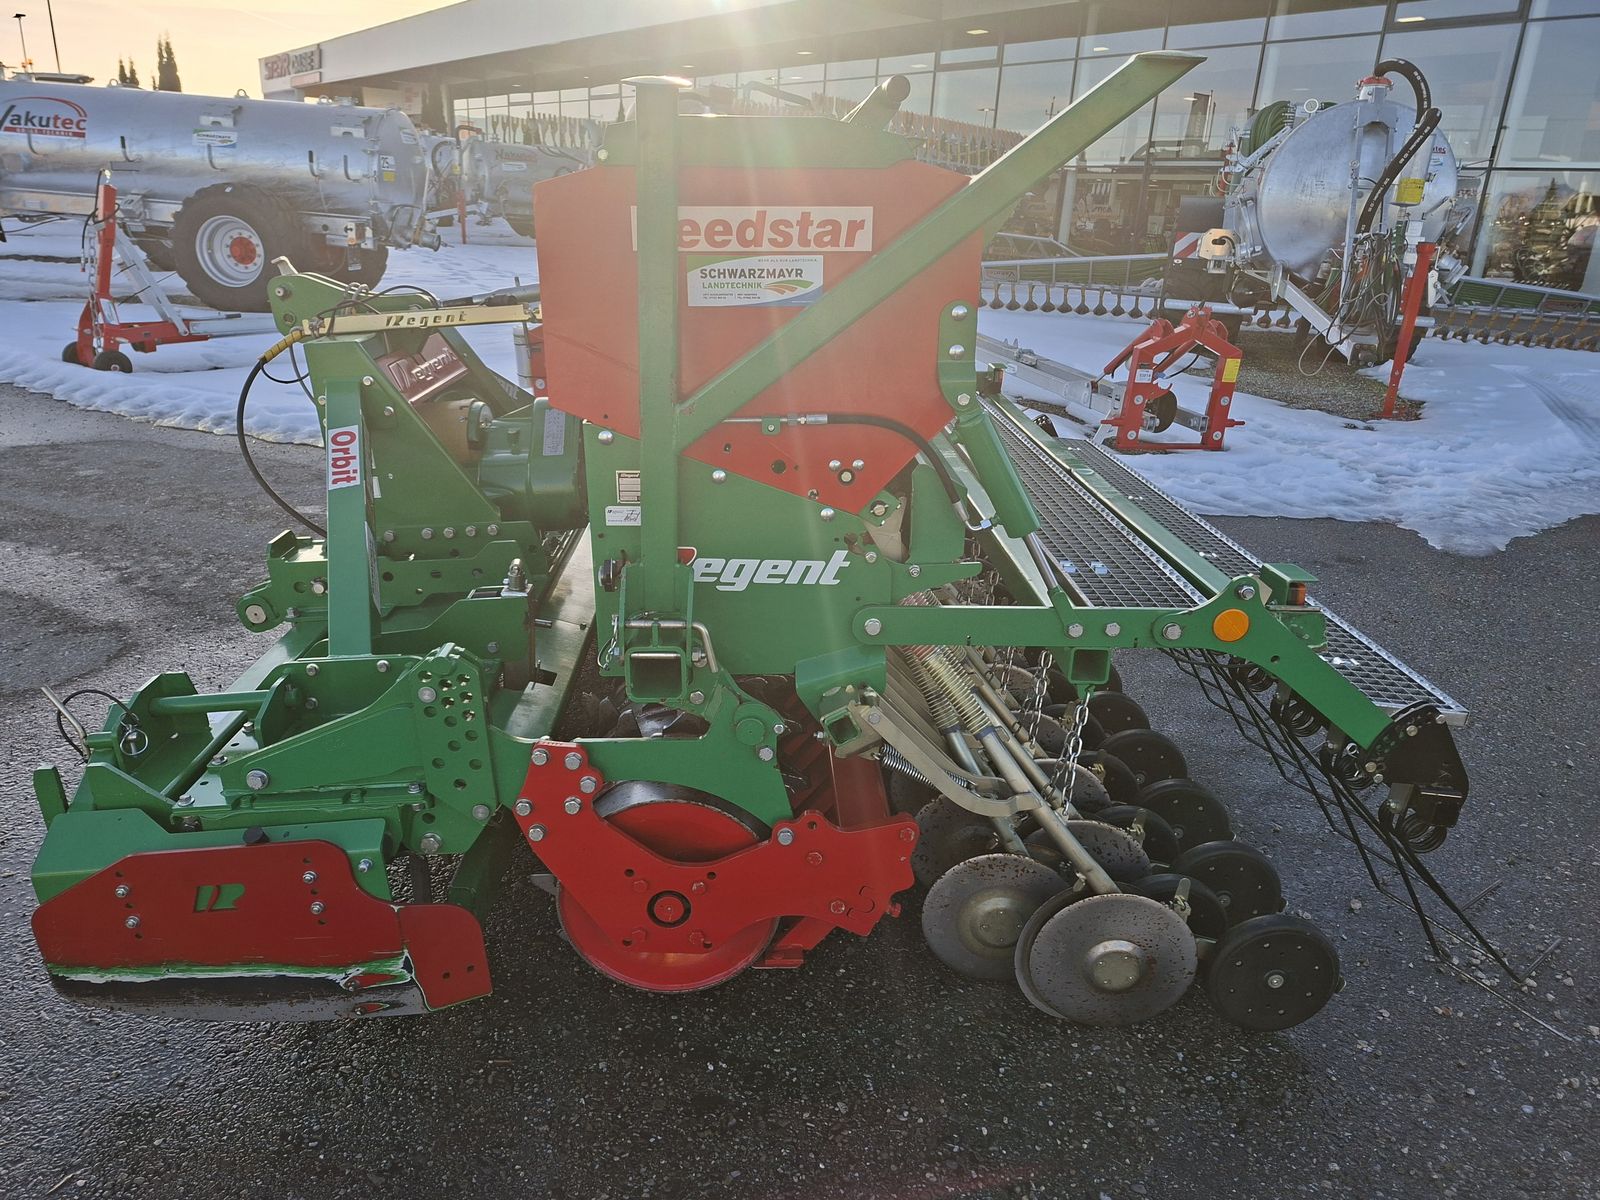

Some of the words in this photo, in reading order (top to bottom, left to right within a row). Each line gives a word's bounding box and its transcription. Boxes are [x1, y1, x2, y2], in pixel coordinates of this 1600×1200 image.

[678, 209, 866, 249] eedstar
[700, 267, 804, 280] SCHWARZMAYR
[702, 281, 762, 290] LANDTECHNIK
[385, 310, 468, 329] Regent
[330, 430, 358, 486] Orbit
